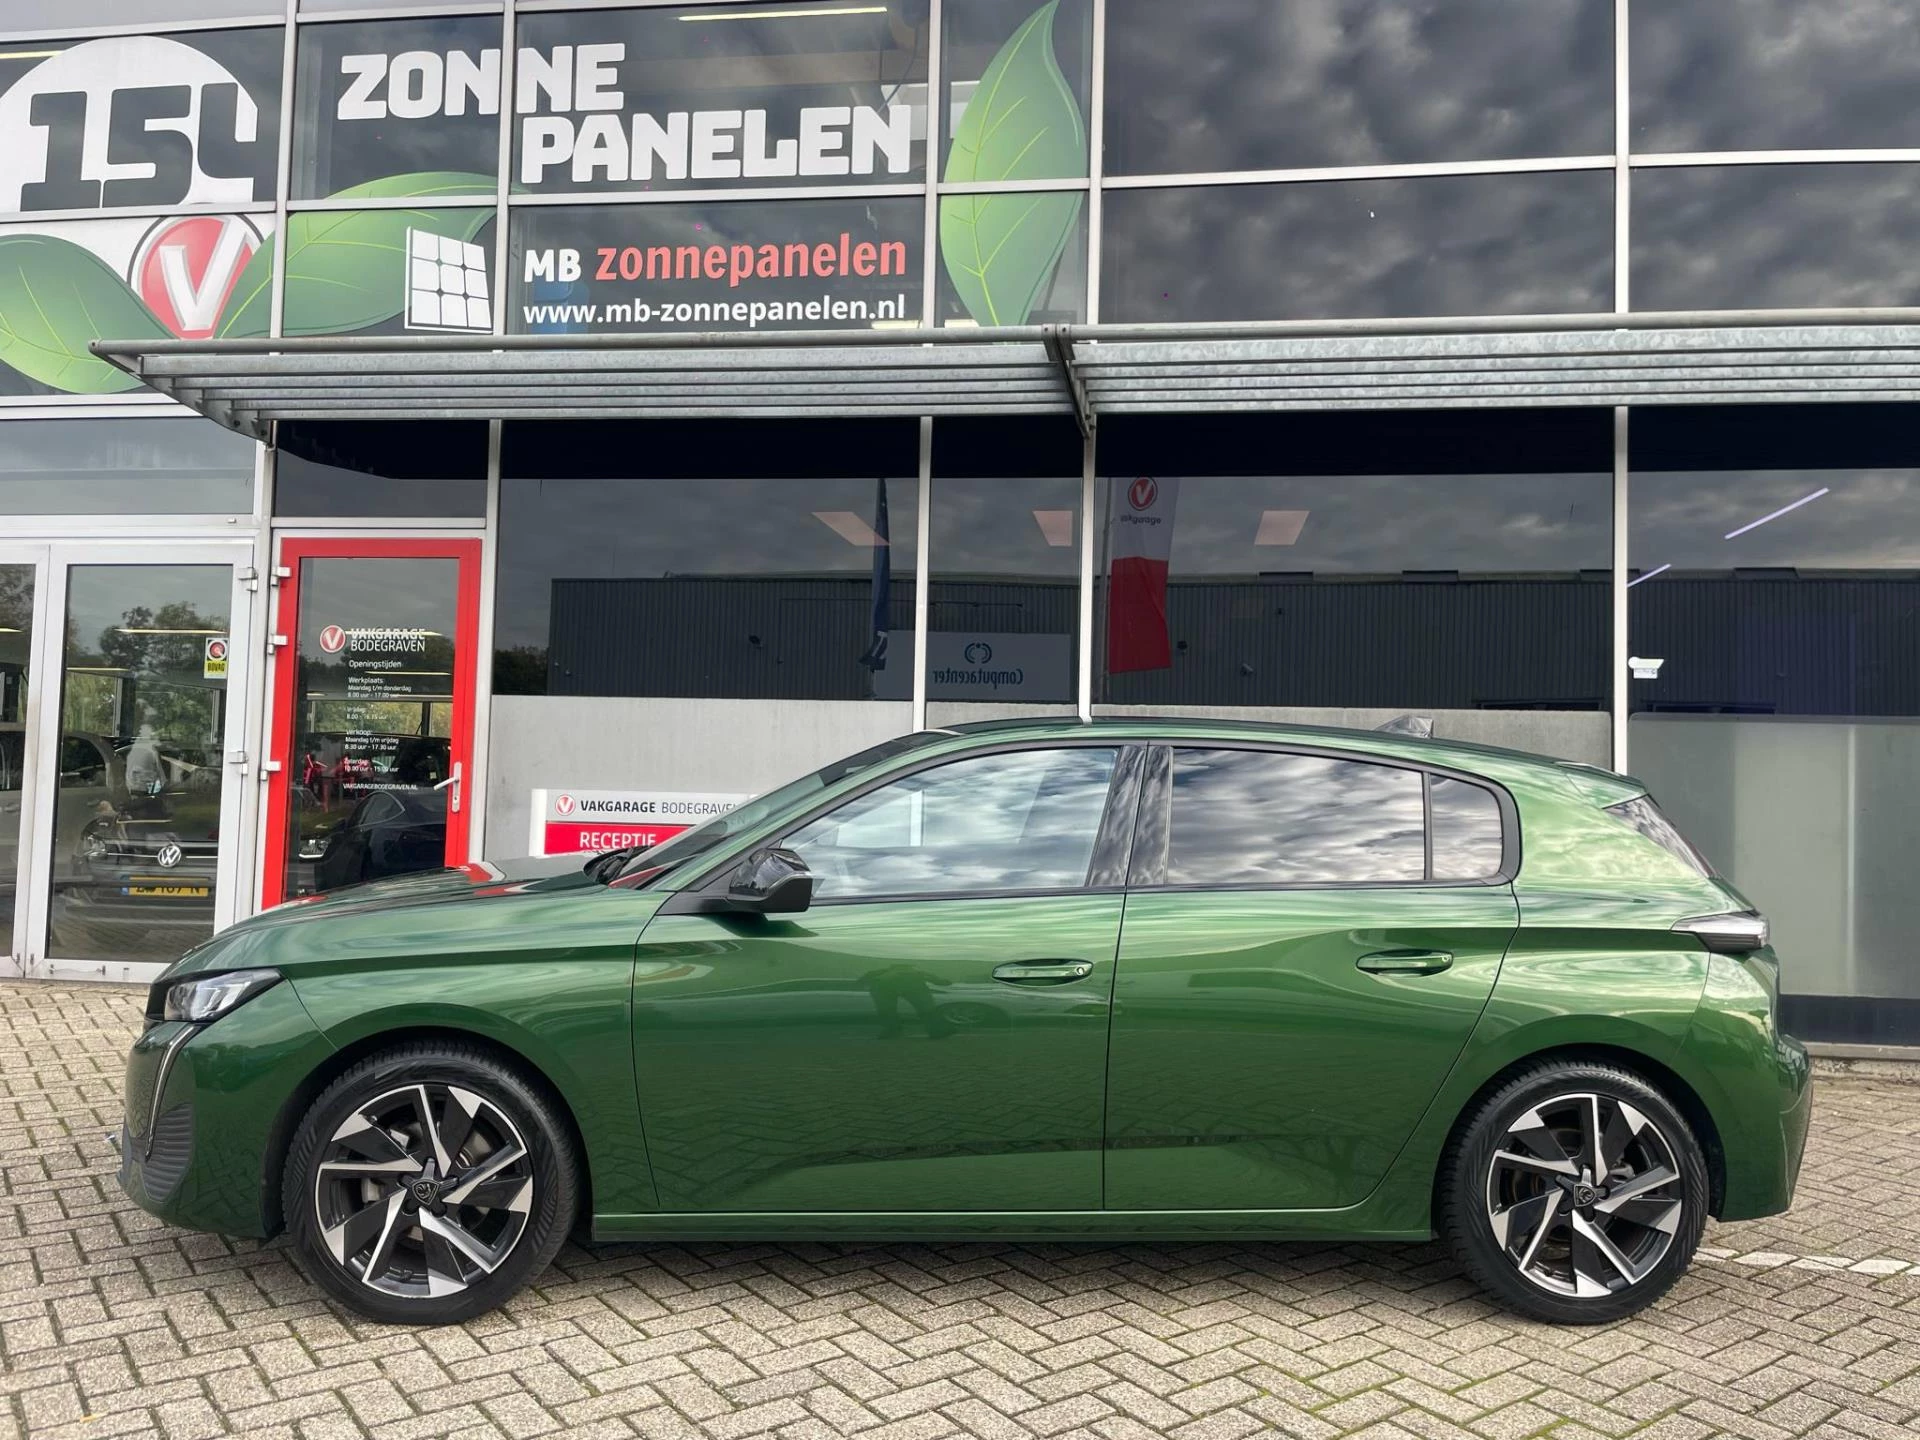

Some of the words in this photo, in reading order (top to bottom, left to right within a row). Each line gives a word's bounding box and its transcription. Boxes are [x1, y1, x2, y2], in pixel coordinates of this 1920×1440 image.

[337, 43, 625, 121] ZONNE
[520, 104, 911, 184] PANELEN
[524, 249, 582, 283] MB
[595, 232, 906, 288] zonnepanelen
[523, 294, 905, 328] www.mb-zonnepanelen.nl
[350, 640, 426, 652] BODEGRAVEN
[348, 659, 402, 669] Openingstijden
[581, 799, 656, 813] VAKGARAGE
[661, 801, 736, 815] BODEGRAVE
[580, 831, 656, 849] RECEPTIE
